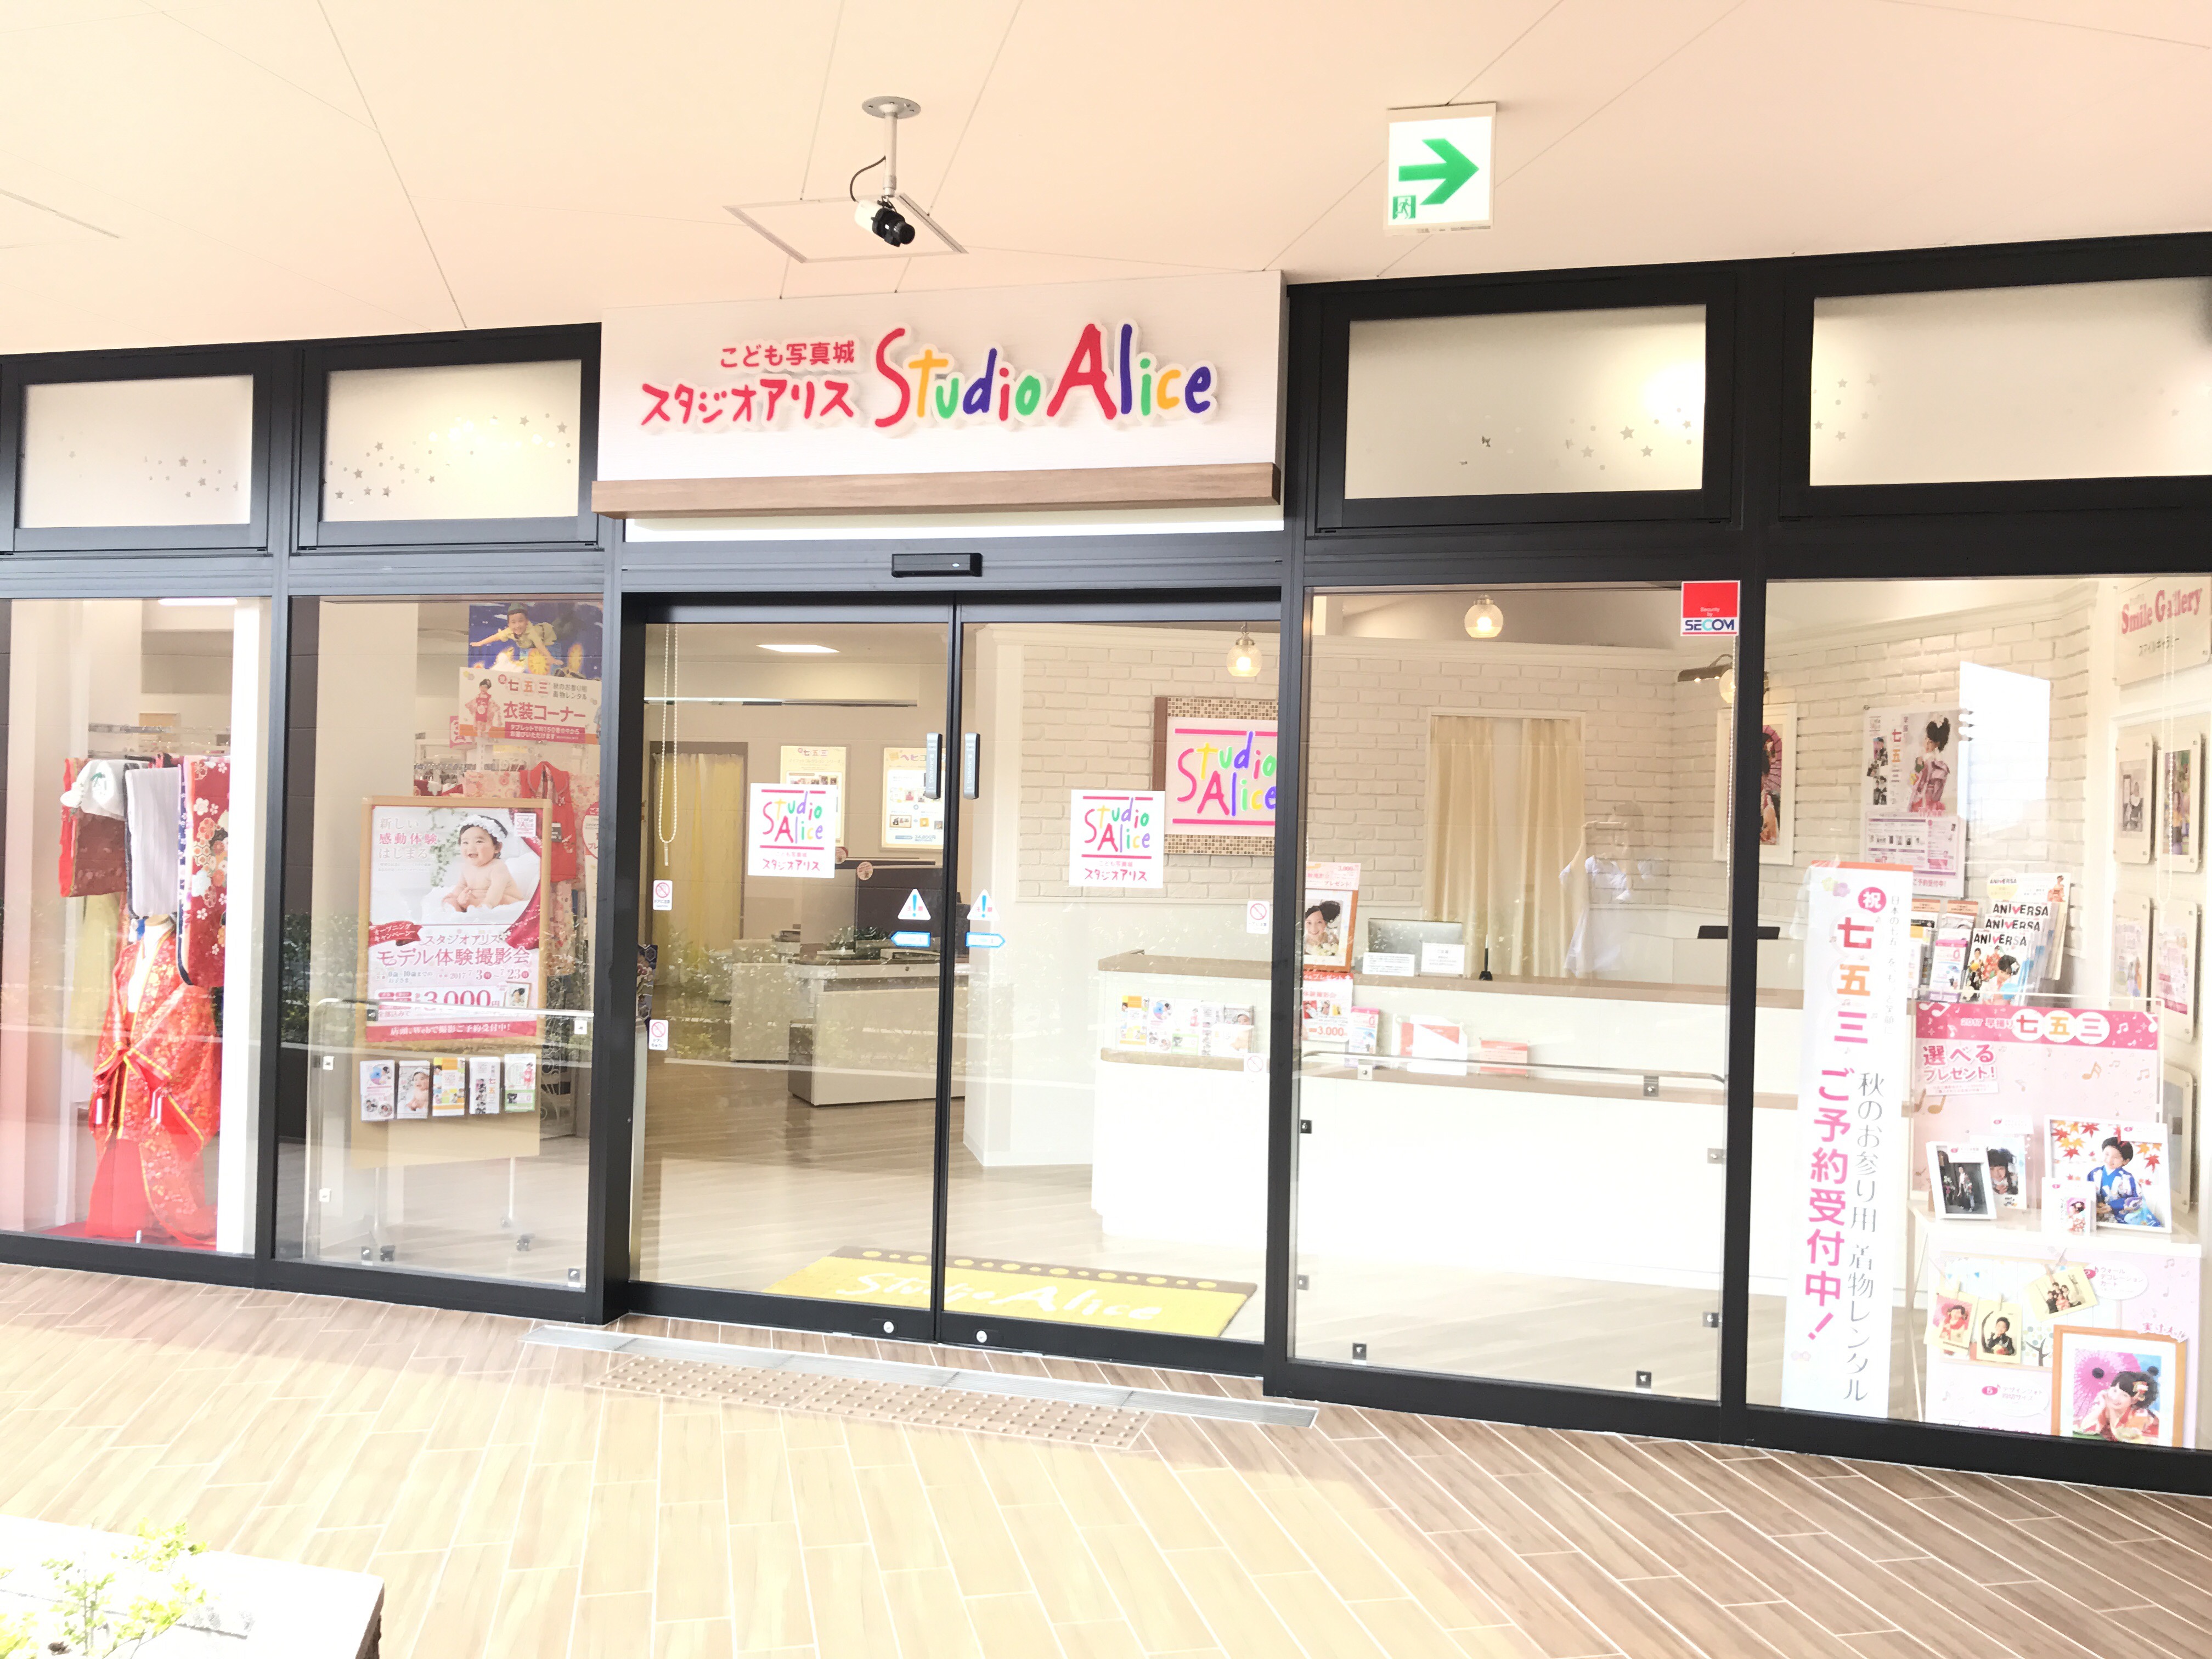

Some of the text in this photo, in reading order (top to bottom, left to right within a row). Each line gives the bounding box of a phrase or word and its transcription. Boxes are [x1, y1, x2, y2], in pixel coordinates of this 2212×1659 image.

[720, 340, 856, 369] こども写真城
[874, 323, 1212, 428] Studio Alice
[640, 377, 855, 426] スタジオアリス
[1685, 619, 1735, 631] SECOM
[2121, 602, 2153, 635] Smile
[508, 679, 549, 695] 七五三
[503, 700, 586, 723] 衣装コーナー
[1176, 731, 1277, 803] Studio
[1197, 770, 1277, 817] Alice
[380, 817, 419, 830] 新しい
[762, 791, 823, 835] Studio
[1084, 797, 1149, 843] Studio
[379, 833, 438, 845] 感動体験
[774, 816, 824, 844] Alice
[1097, 823, 1151, 853] Alice
[762, 858, 821, 872] スタジオアリス
[1084, 868, 1148, 882] スタジオアリス
[1862, 891, 1882, 910] 祝
[1992, 903, 2049, 917] ANIVERSA
[1985, 918, 2041, 932] ANIVERSA
[420, 934, 501, 946] スタジオアリス
[1973, 933, 2027, 946] ANIVERSA
[377, 946, 531, 968] モデル体験撮影会
[1833, 917, 1875, 1045] 七五三
[1960, 1018, 1984, 1027] 2017
[2016, 1014, 2103, 1037] 七五三
[1922, 1043, 1995, 1066] 選べる
[1923, 1065, 1996, 1083] プレゼント!
[1804, 1067, 1855, 1340] ご予約受付中!
[1843, 1072, 1884, 1402] 秋のお参り用 着物レンタル
[990, 1285, 1163, 1320] Alice
